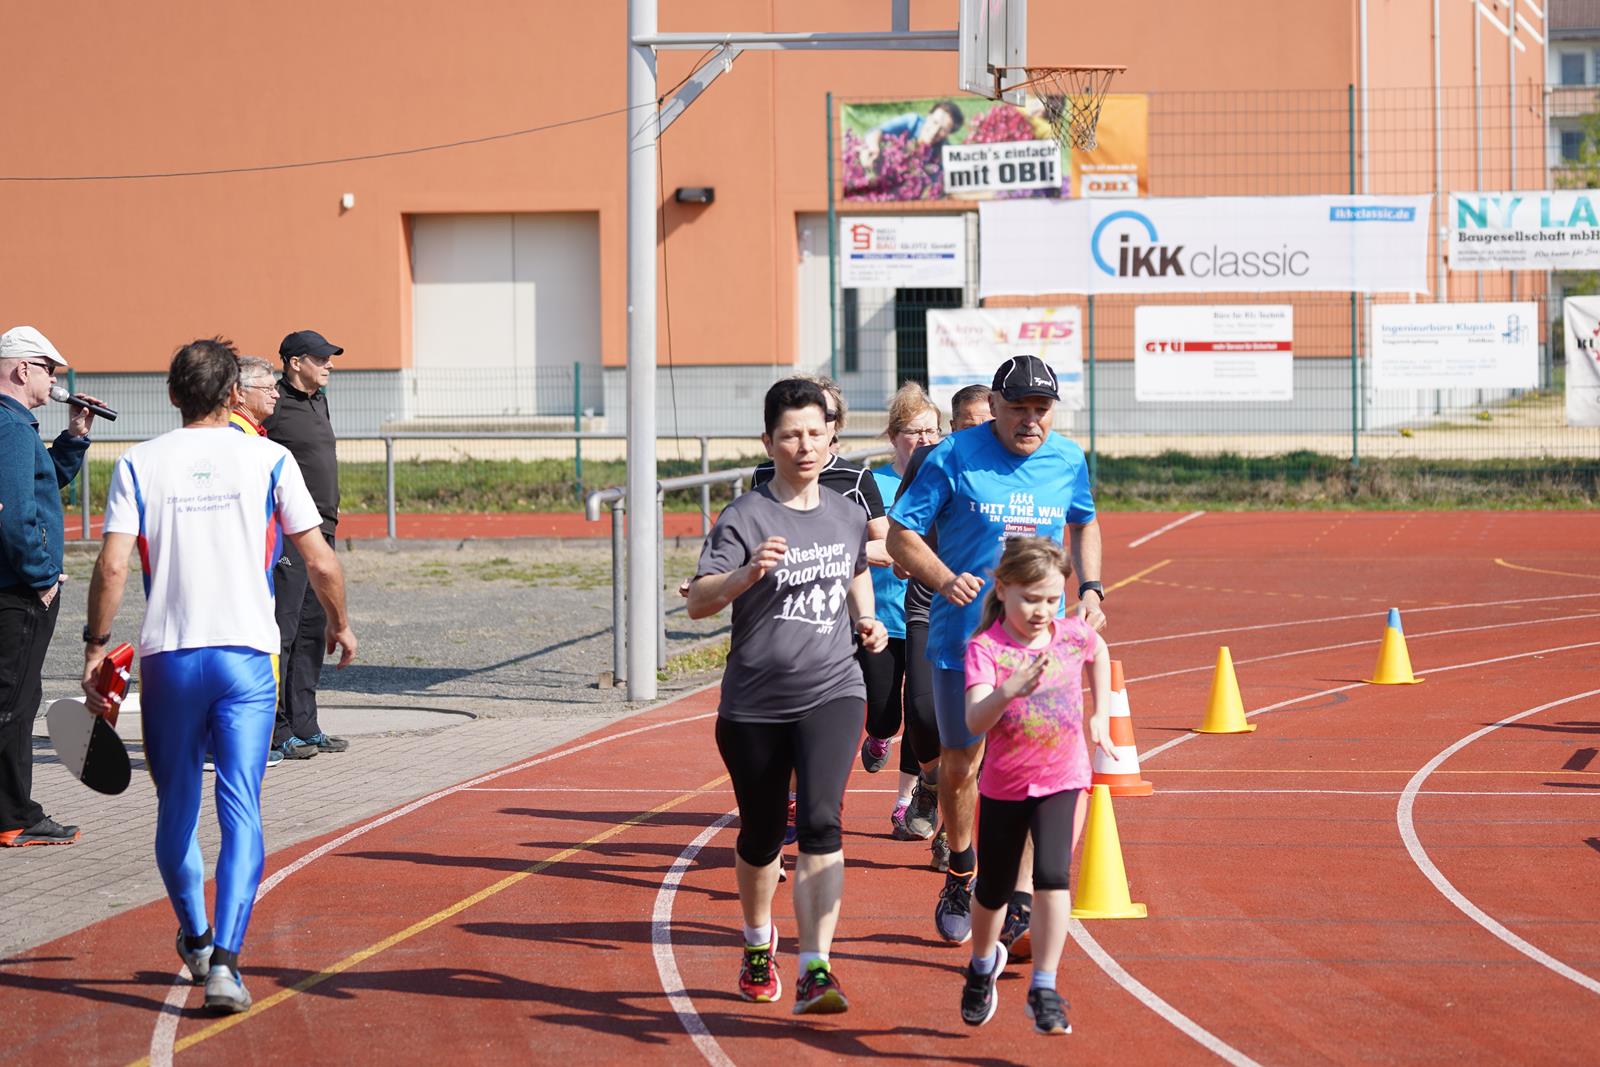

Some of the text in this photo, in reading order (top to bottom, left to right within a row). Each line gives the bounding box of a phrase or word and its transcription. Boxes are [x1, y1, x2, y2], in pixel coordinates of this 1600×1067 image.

[949, 144, 1056, 162] Mach's einfach
[950, 161, 1055, 186] mit OBI!
[1457, 198, 1523, 229] NY
[1458, 231, 1600, 244] Baugesellschaft mbH
[1190, 244, 1309, 277] classic
[1018, 320, 1075, 340] ETS
[969, 501, 976, 512] I
[980, 502, 1005, 514] HIT
[1009, 504, 1034, 516] THE
[1002, 516, 1052, 525] CONNEMARA
[784, 542, 845, 566] Nieskyer
[775, 553, 851, 591] Paarlauf
